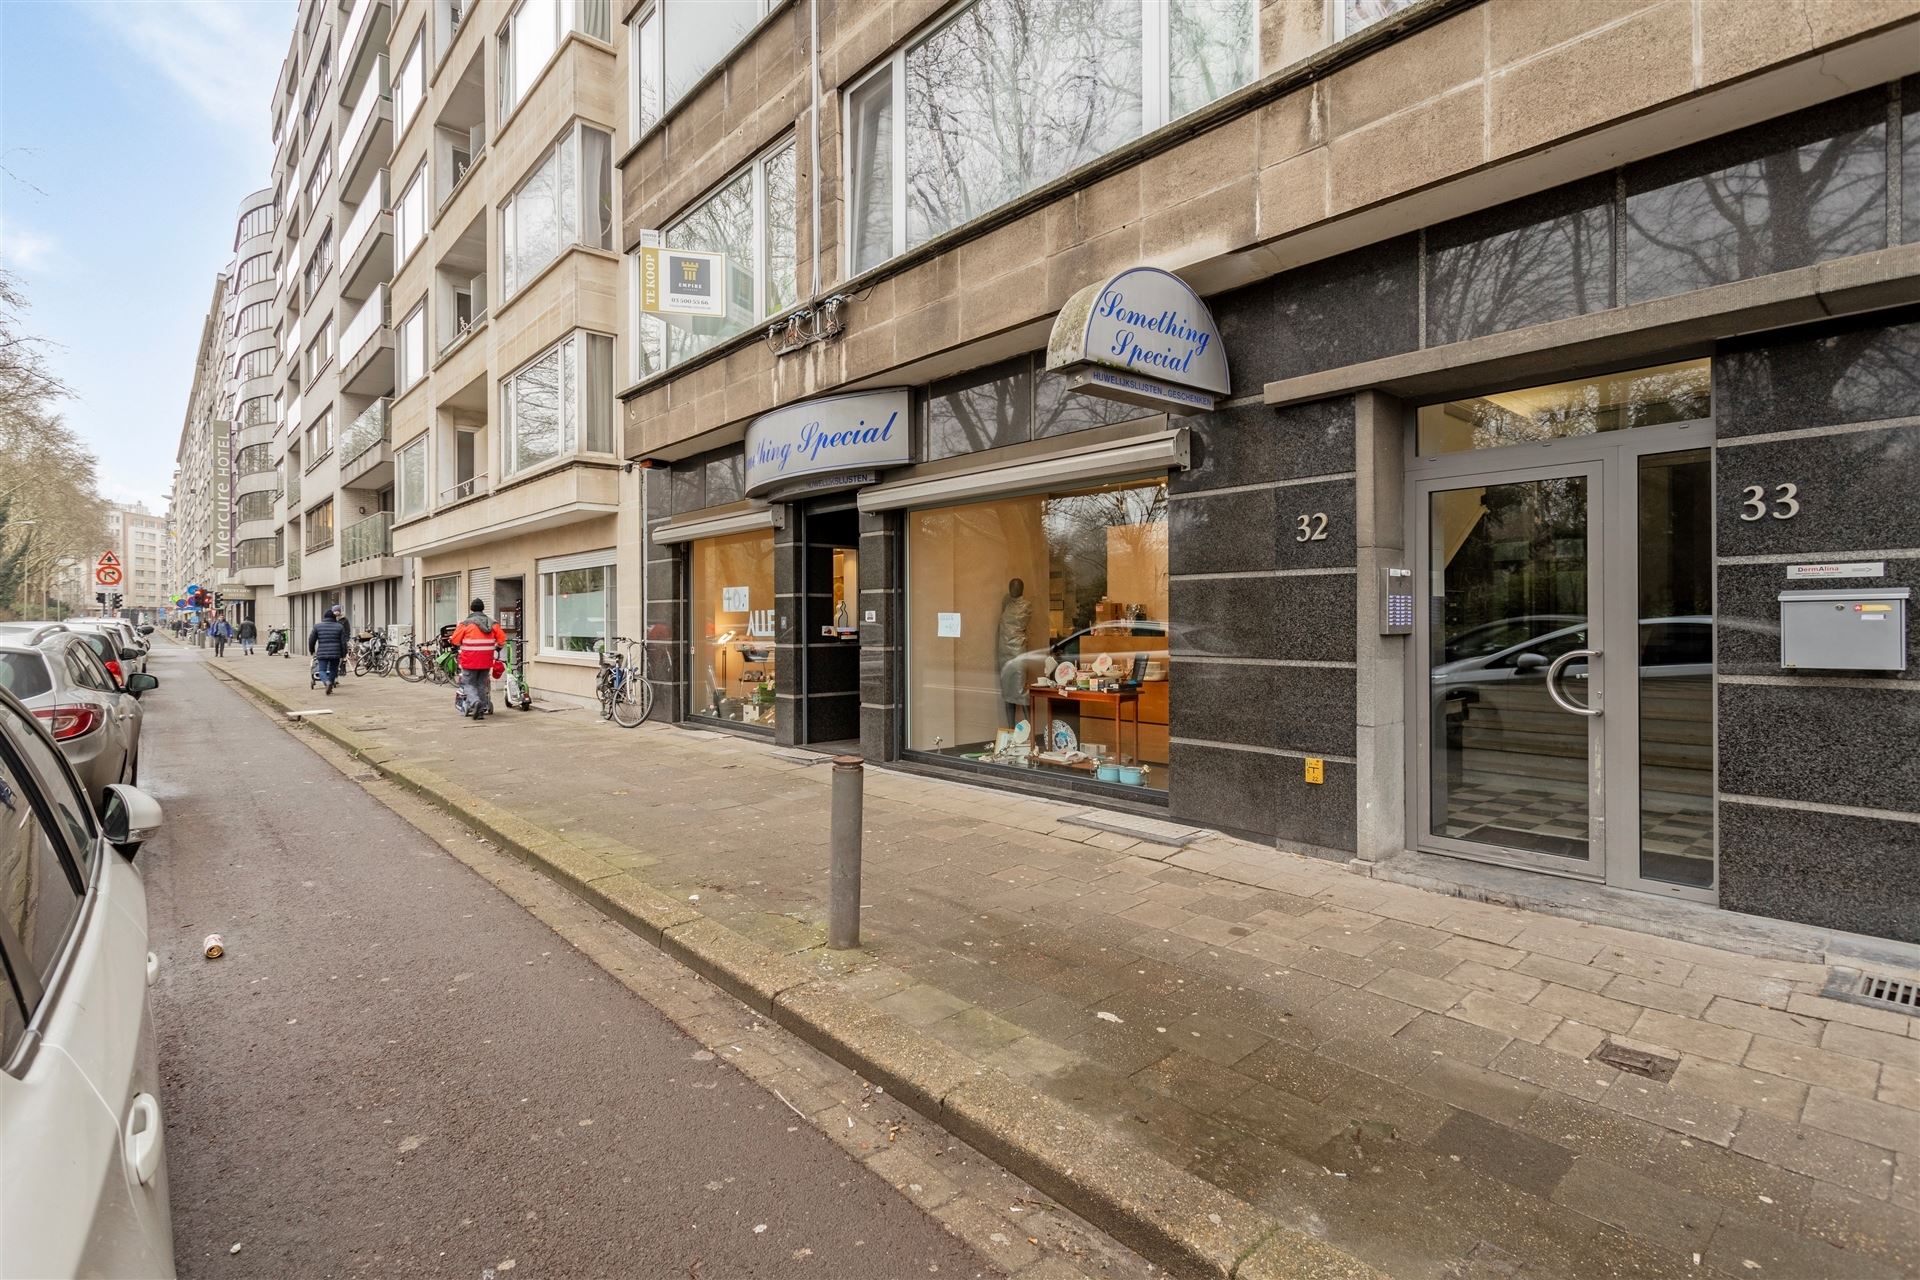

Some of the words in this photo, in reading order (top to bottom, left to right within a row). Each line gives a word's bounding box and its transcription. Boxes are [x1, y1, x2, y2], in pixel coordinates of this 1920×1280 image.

[645, 254, 656, 288] KOOP
[645, 289, 656, 304] TE
[1100, 291, 1210, 356] Something
[1111, 330, 1194, 373] Special
[1092, 371, 1163, 396] HUWELIJKSLIJSTEN
[1167, 389, 1212, 406] GESCHENKEN
[217, 432, 230, 477] HOTEL
[797, 411, 898, 461] Special
[215, 482, 230, 557] Mercure
[1740, 482, 1800, 522] 33
[1296, 512, 1329, 542] 32
[1797, 565, 1840, 573] DermAlina
